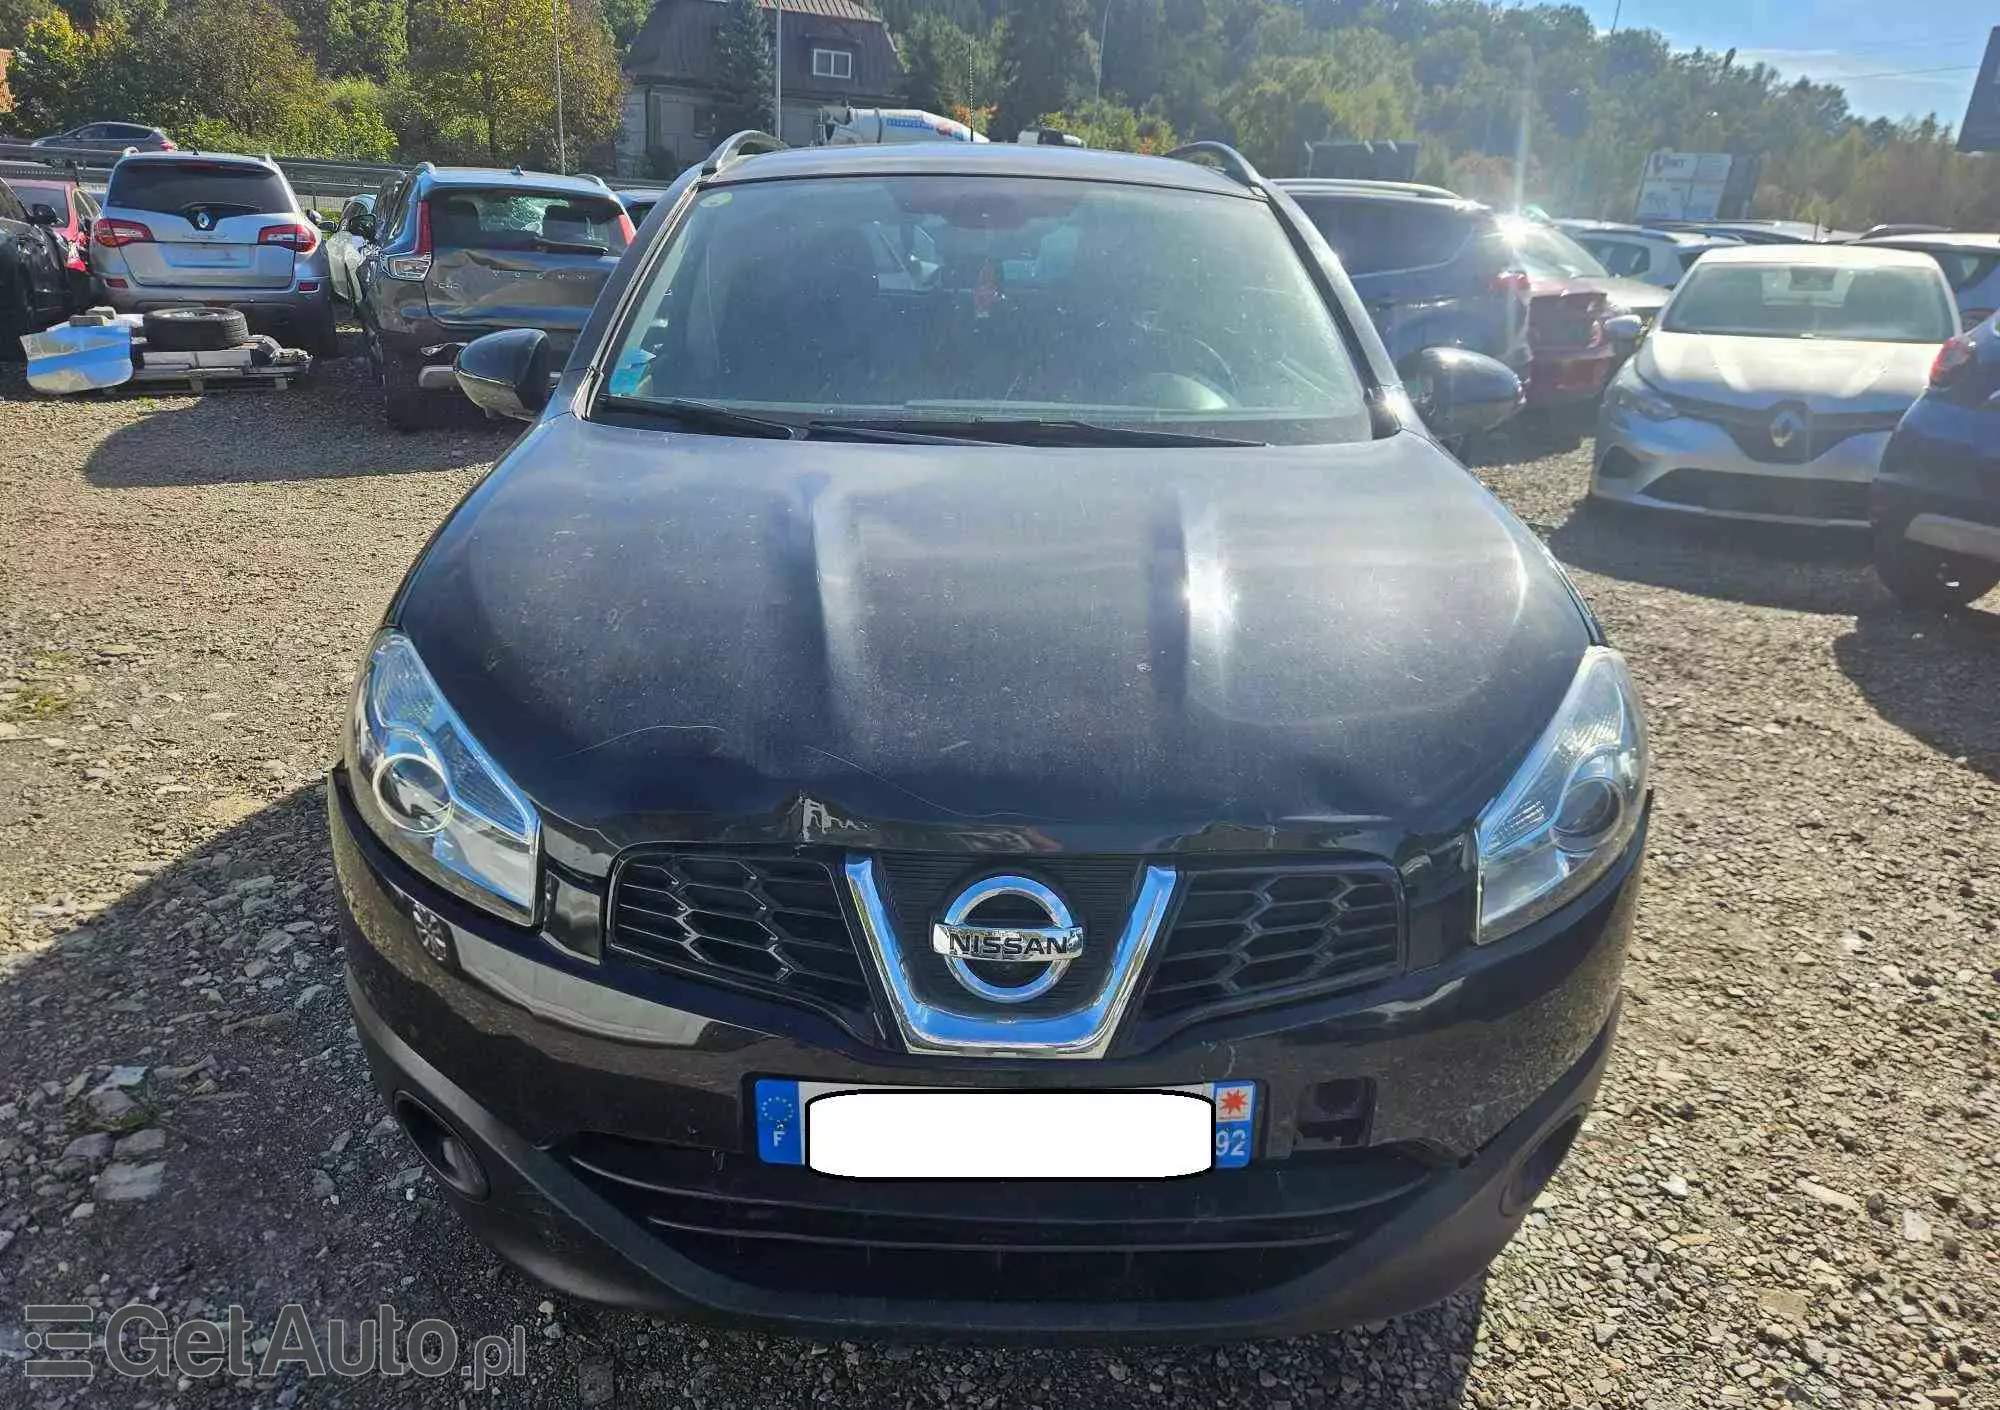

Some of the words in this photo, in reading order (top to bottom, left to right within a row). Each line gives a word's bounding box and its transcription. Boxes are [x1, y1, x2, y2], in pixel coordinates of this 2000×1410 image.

[949, 932, 1067, 955] NISSAN
[774, 1130, 786, 1147] F
[1216, 1129, 1246, 1156] 92
